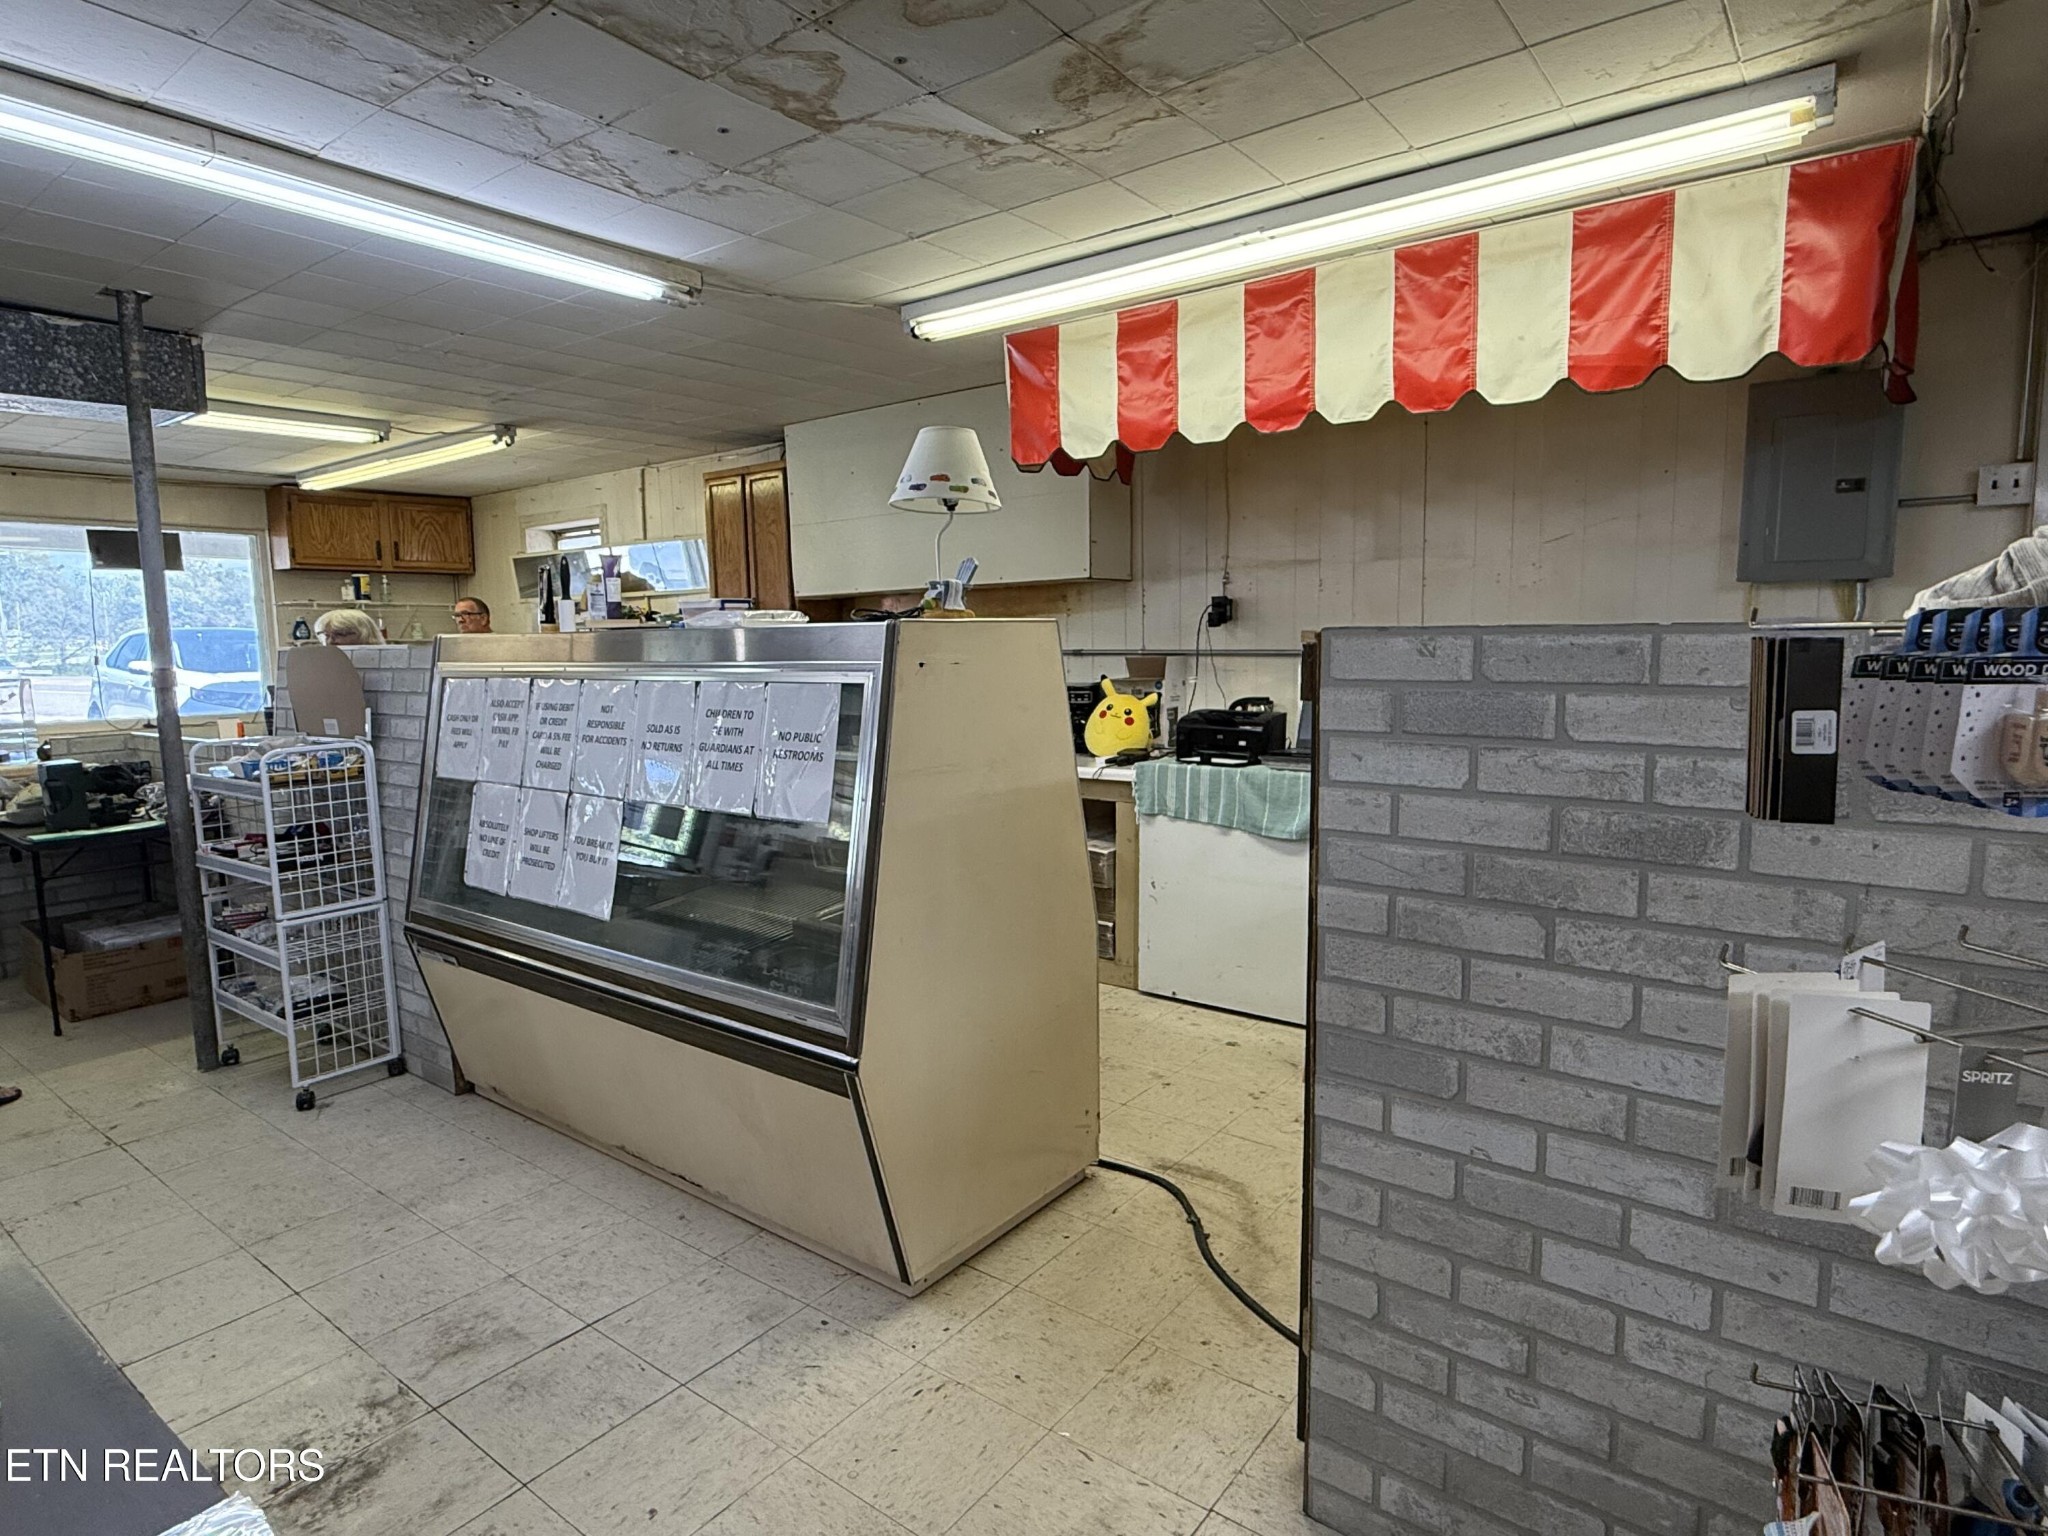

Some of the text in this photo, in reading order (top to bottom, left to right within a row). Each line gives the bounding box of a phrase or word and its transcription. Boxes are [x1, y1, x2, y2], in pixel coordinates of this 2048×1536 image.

[1983, 664, 2037, 677] WOOD
[490, 700, 525, 709] ALSO ACCEPT
[558, 703, 575, 712] DEBIT
[600, 704, 614, 714] NOT
[743, 710, 754, 720] TO
[540, 718, 567, 727] OR CREDIT
[586, 719, 626, 730] RESPONSIBLE
[646, 723, 681, 735] SOLD AS IS
[723, 727, 744, 737] WITH
[547, 732, 553, 740] A
[562, 733, 572, 742] FEE
[581, 734, 628, 746] FOR ACCIDENTS
[778, 731, 823, 744] NO PUBLIC
[453, 741, 468, 749] APPLY
[498, 740, 509, 748] PAY
[641, 741, 683, 753] NO RETURNS
[699, 742, 755, 755] GUARDIANS AT
[540, 746, 562, 756] WILL BE
[535, 760, 562, 771] CHARGED
[706, 760, 744, 772] ALL TIMES
[479, 820, 510, 832] ABSOLUTELY
[524, 827, 559, 841] SHOP LIFTERS
[479, 834, 488, 843] NO
[500, 837, 506, 846] OF
[573, 836, 586, 846] YOU
[586, 838, 607, 849] BREAK
[482, 848, 500, 859] CREDIT
[530, 843, 550, 854] WILL BE
[521, 856, 556, 871] PROSECUTED
[576, 852, 608, 866] YOU BUY IT
